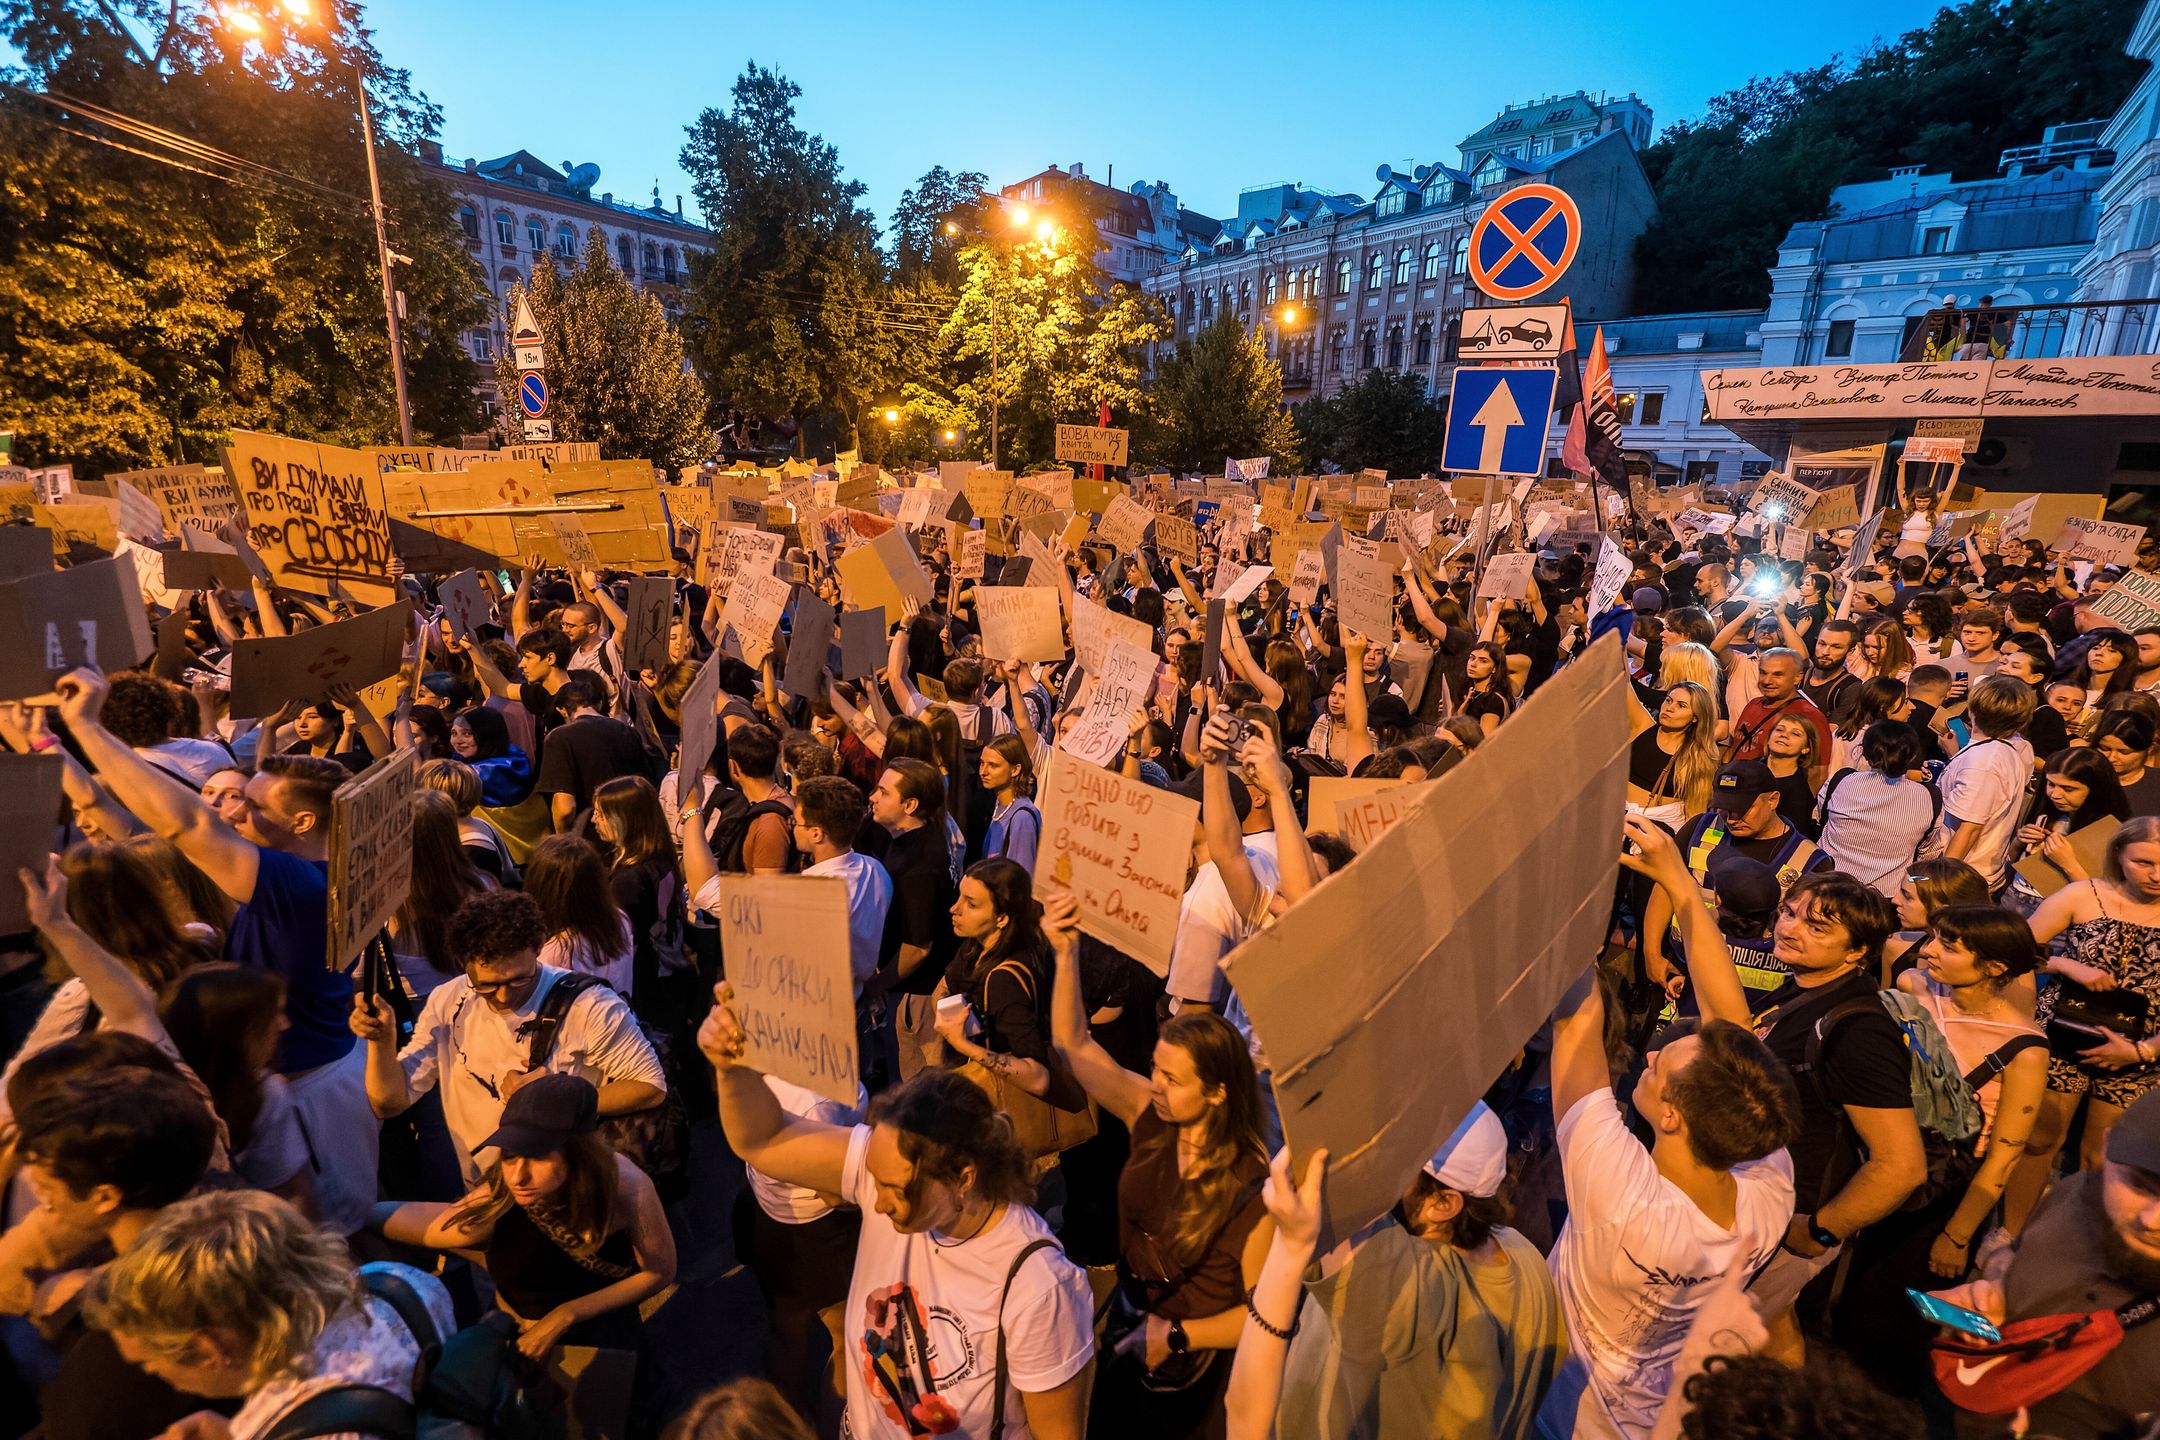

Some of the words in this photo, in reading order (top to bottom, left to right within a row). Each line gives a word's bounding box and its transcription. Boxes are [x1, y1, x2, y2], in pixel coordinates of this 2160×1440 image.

[1833, 367, 1901, 388] Віктор
[1995, 364, 2086, 387] Михайло
[1733, 399, 1801, 416] Катерина
[1902, 388, 1981, 405] Микола
[1060, 427, 1089, 440] ВОВА
[1093, 430, 1122, 442] КУПУЄ
[1061, 441, 1092, 449] КВИТОК
[1060, 450, 1071, 459] ДО
[1075, 451, 1107, 461] РОСТОВА
[199, 485, 232, 499] ДУМА
[252, 457, 279, 490] ВИ
[287, 463, 367, 506] ДУМАЛИ
[1770, 478, 1809, 500] ЄДИНИМ
[247, 491, 274, 511] ПРО
[2099, 525, 2108, 536] ТА
[251, 523, 282, 549] ПРО
[283, 516, 394, 575] СВОБОДУ
[1086, 682, 1132, 720] НАБУ
[1060, 762, 1120, 804] ЗНАЮ
[1727, 944, 1765, 967] ОЛІЦІЯ
